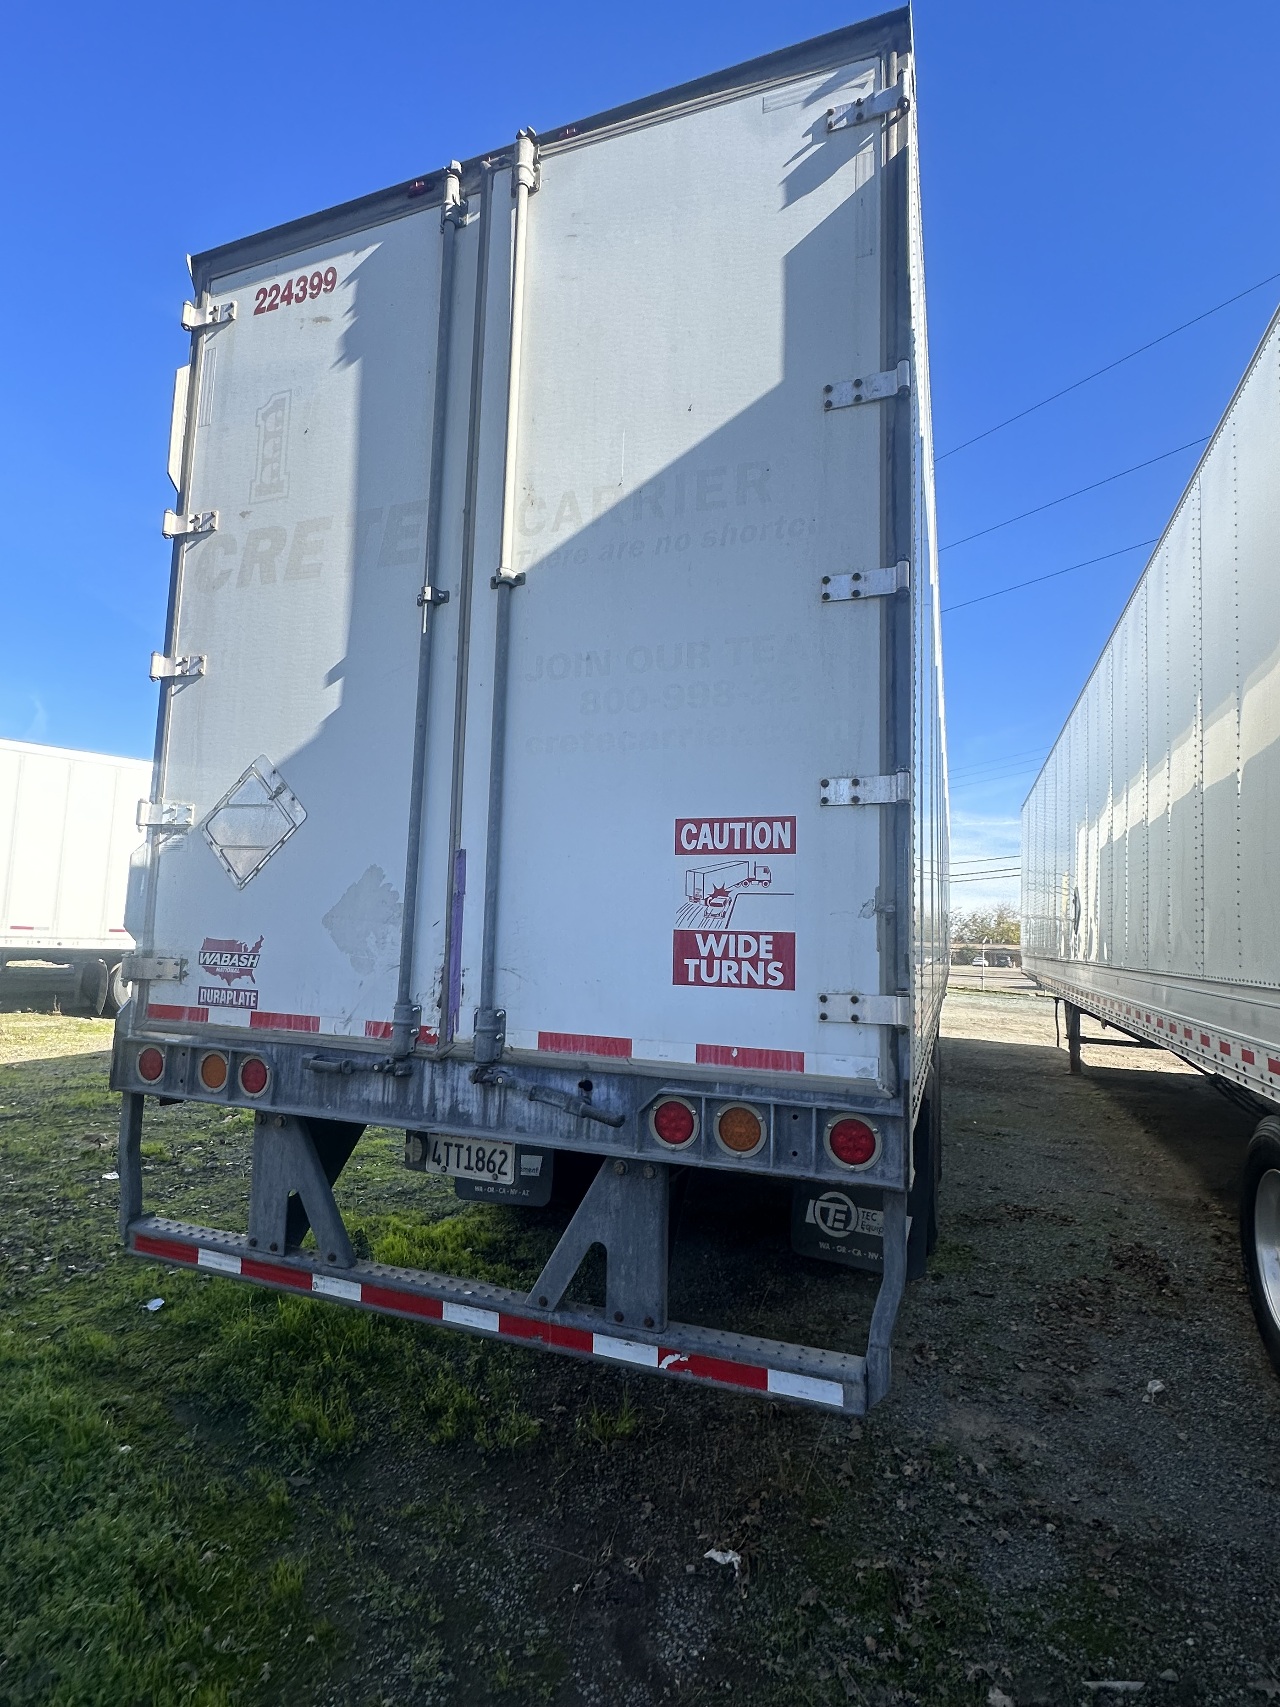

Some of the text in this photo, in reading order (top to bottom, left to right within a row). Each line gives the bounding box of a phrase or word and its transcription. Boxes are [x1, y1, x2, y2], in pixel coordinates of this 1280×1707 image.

[253, 266, 338, 316] 224399
[517, 460, 772, 537] CARRIER
[194, 499, 430, 593] CRETE
[599, 538, 646, 562] are
[653, 531, 692, 556] no
[524, 648, 612, 682] JOIN
[626, 641, 712, 673] OUR
[680, 820, 791, 850] CAUTION
[199, 952, 260, 967] WABASH
[695, 933, 774, 959] WIDE
[684, 958, 785, 987] TURNS
[199, 988, 257, 1007] DURAPLATE
[432, 1140, 508, 1176] 4TT1862
[861, 1210, 878, 1221] TEC
[861, 1221, 884, 1233] Equip
